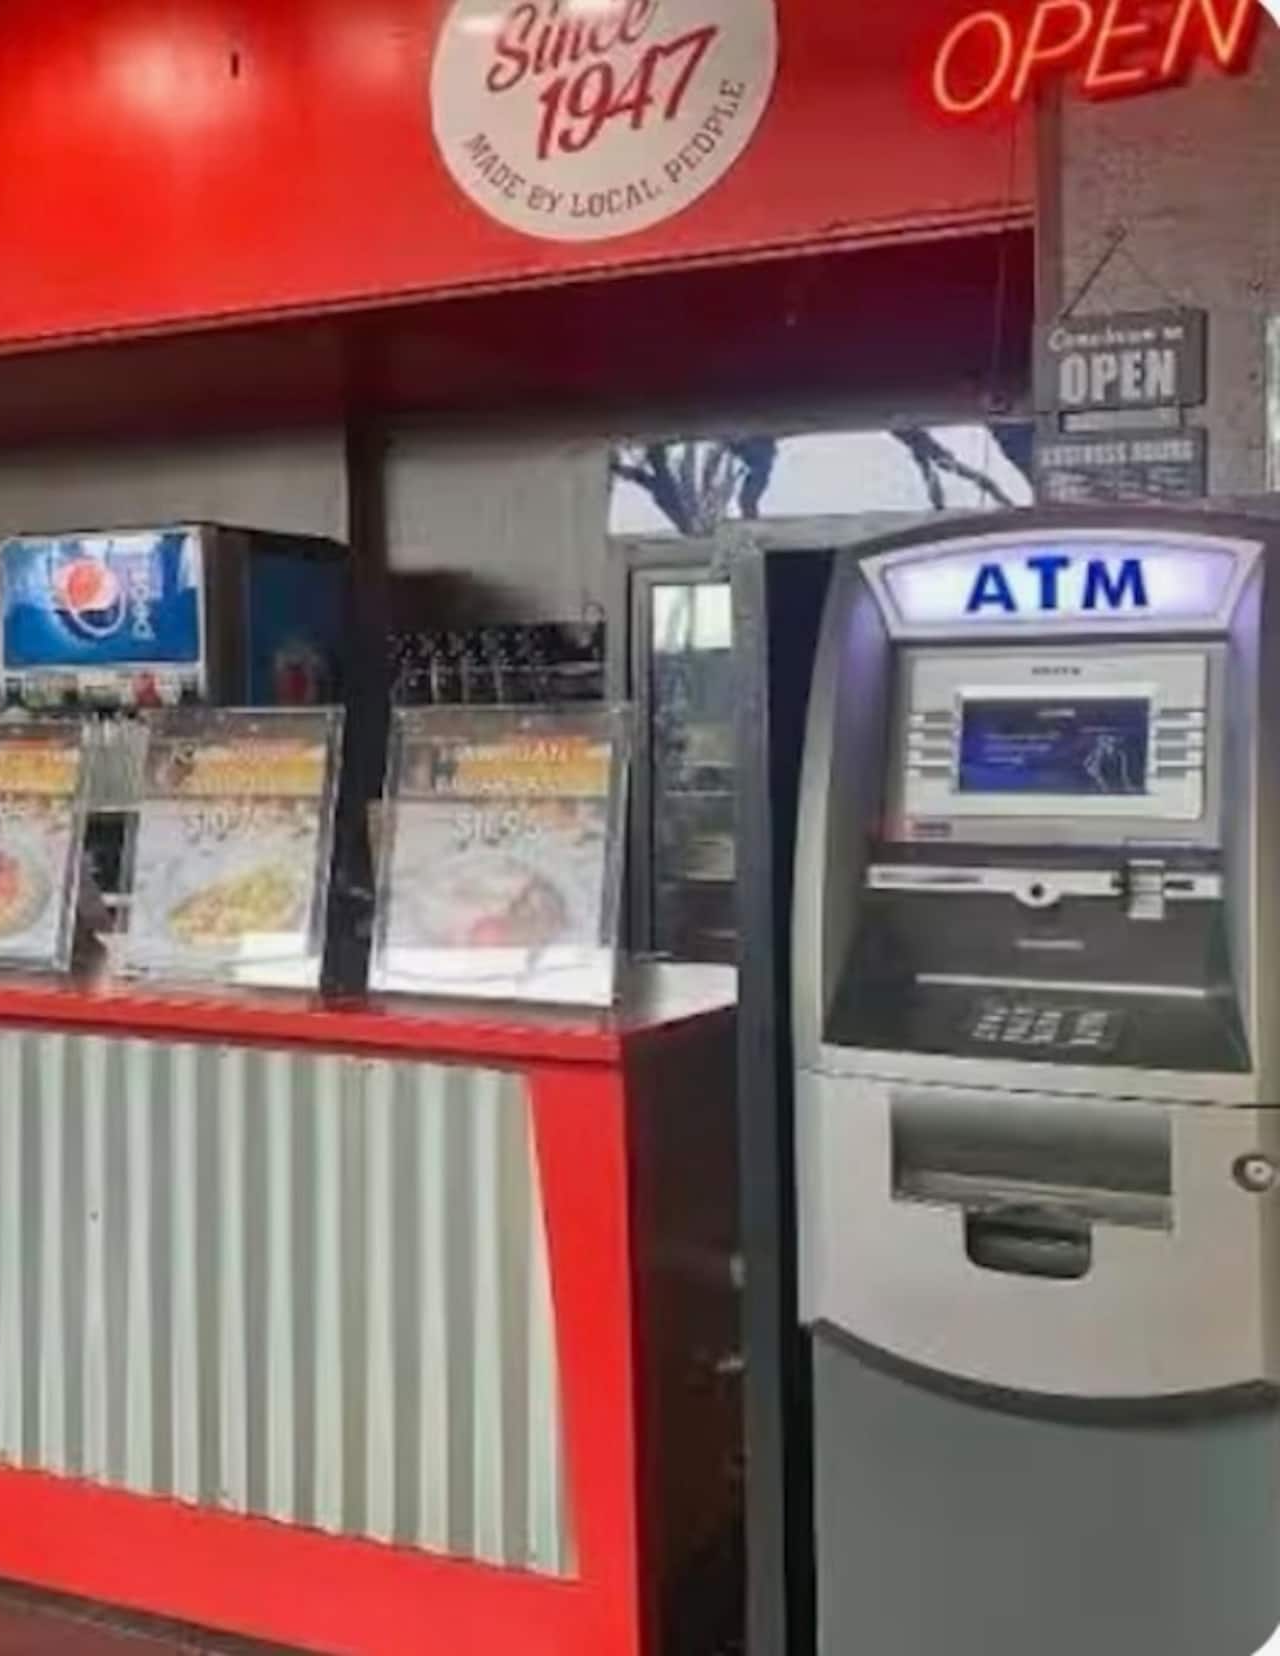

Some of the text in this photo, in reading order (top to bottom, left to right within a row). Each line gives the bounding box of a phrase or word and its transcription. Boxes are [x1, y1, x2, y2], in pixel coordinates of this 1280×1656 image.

[486, 0, 658, 93] Since
[536, 24, 719, 161] 1947
[933, 0, 1248, 112] OPEN
[461, 78, 745, 218] MADE BY LOCAL PEOPLE
[1058, 348, 1176, 403] OPEN
[963, 554, 1150, 614] ATM
